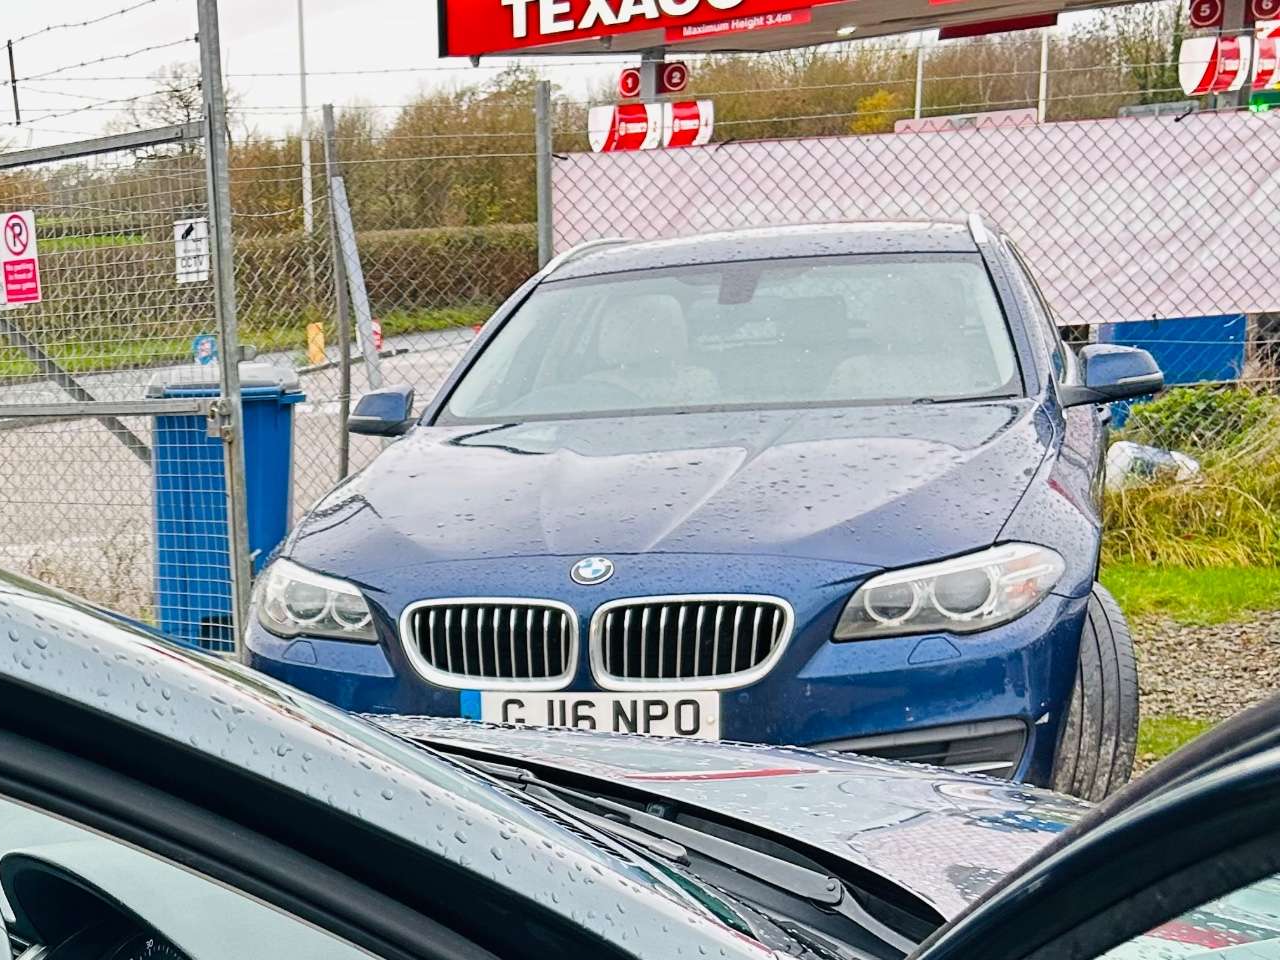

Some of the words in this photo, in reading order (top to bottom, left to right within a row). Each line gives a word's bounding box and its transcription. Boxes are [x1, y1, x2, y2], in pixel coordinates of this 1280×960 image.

[1200, 4, 1210, 16] 5
[683, 20, 729, 37] Maximum
[731, 16, 764, 30] Height
[766, 12, 792, 25] 3.4m
[672, 72, 681, 83] 2
[12, 222, 23, 247] P
[613, 700, 700, 735] NPO
